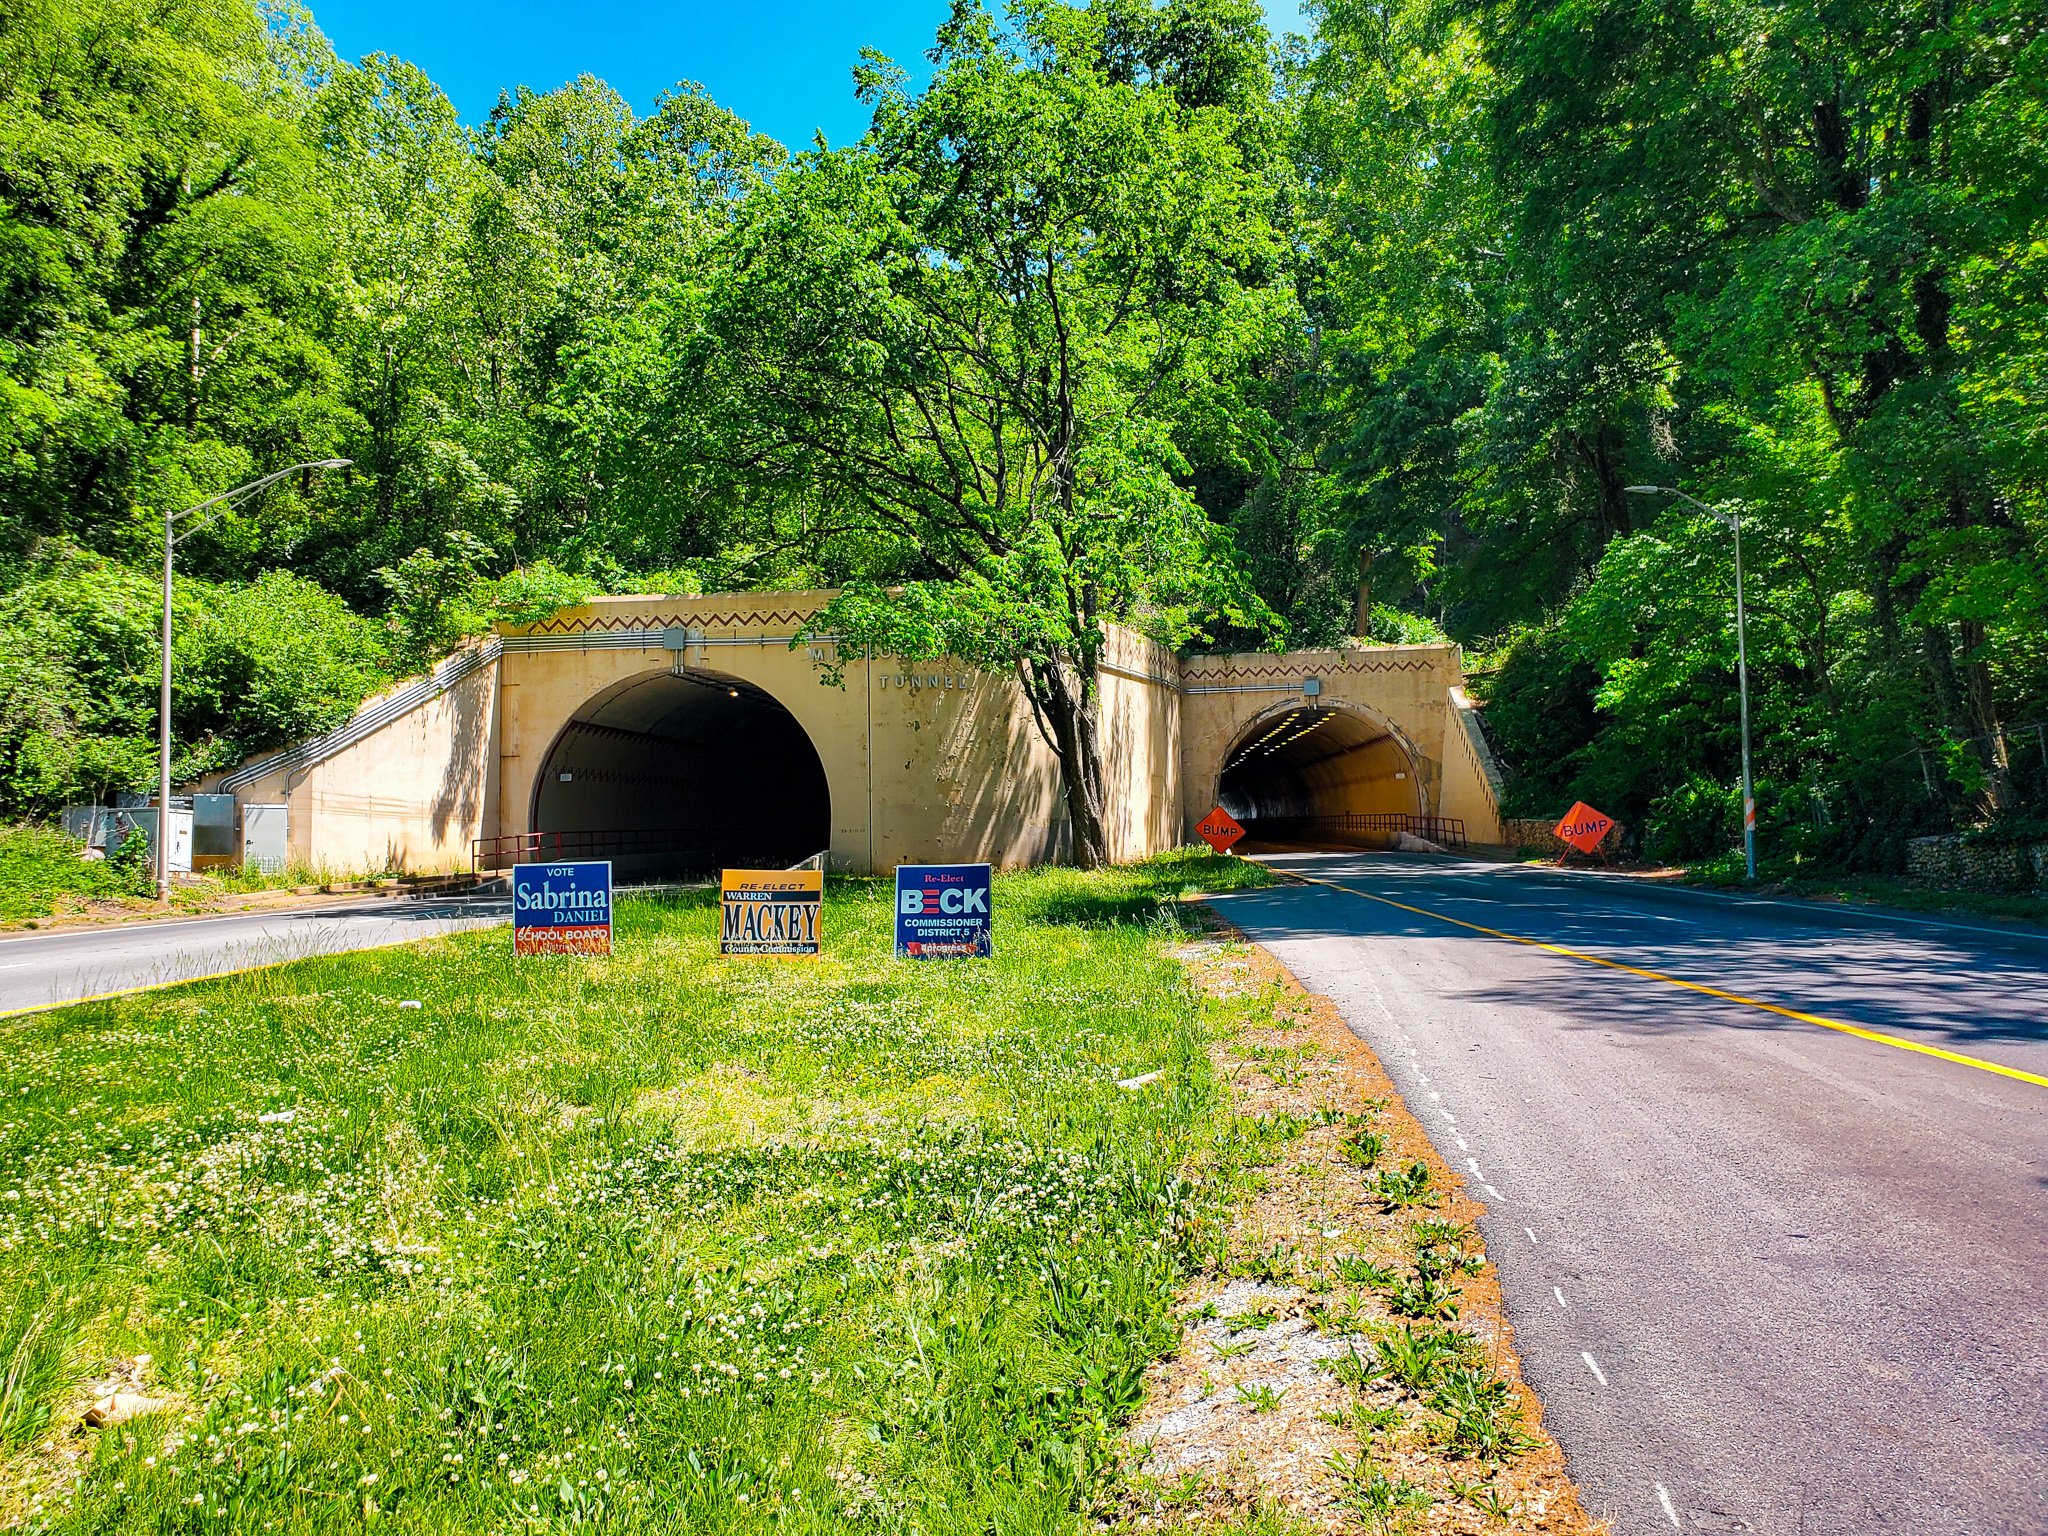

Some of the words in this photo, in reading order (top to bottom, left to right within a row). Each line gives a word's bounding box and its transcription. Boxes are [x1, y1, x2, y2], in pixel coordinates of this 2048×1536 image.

[879, 674, 968, 690] TUNNEL
[1203, 824, 1238, 837] BUMP
[1563, 819, 1608, 837] BUMP
[546, 867, 575, 877] VOTE
[924, 874, 964, 883] Re-Elect
[516, 880, 608, 910] Sabrina
[725, 891, 773, 901] WARREN
[900, 888, 988, 914] BECK
[553, 909, 608, 923] DANIEL
[904, 918, 983, 927] COMMISSIONER
[722, 904, 819, 942] MACKEY
[517, 929, 563, 941] SCHOOL
[565, 928, 608, 940] BOARD
[917, 928, 961, 937] DISTRICT
[963, 928, 970, 936] 5
